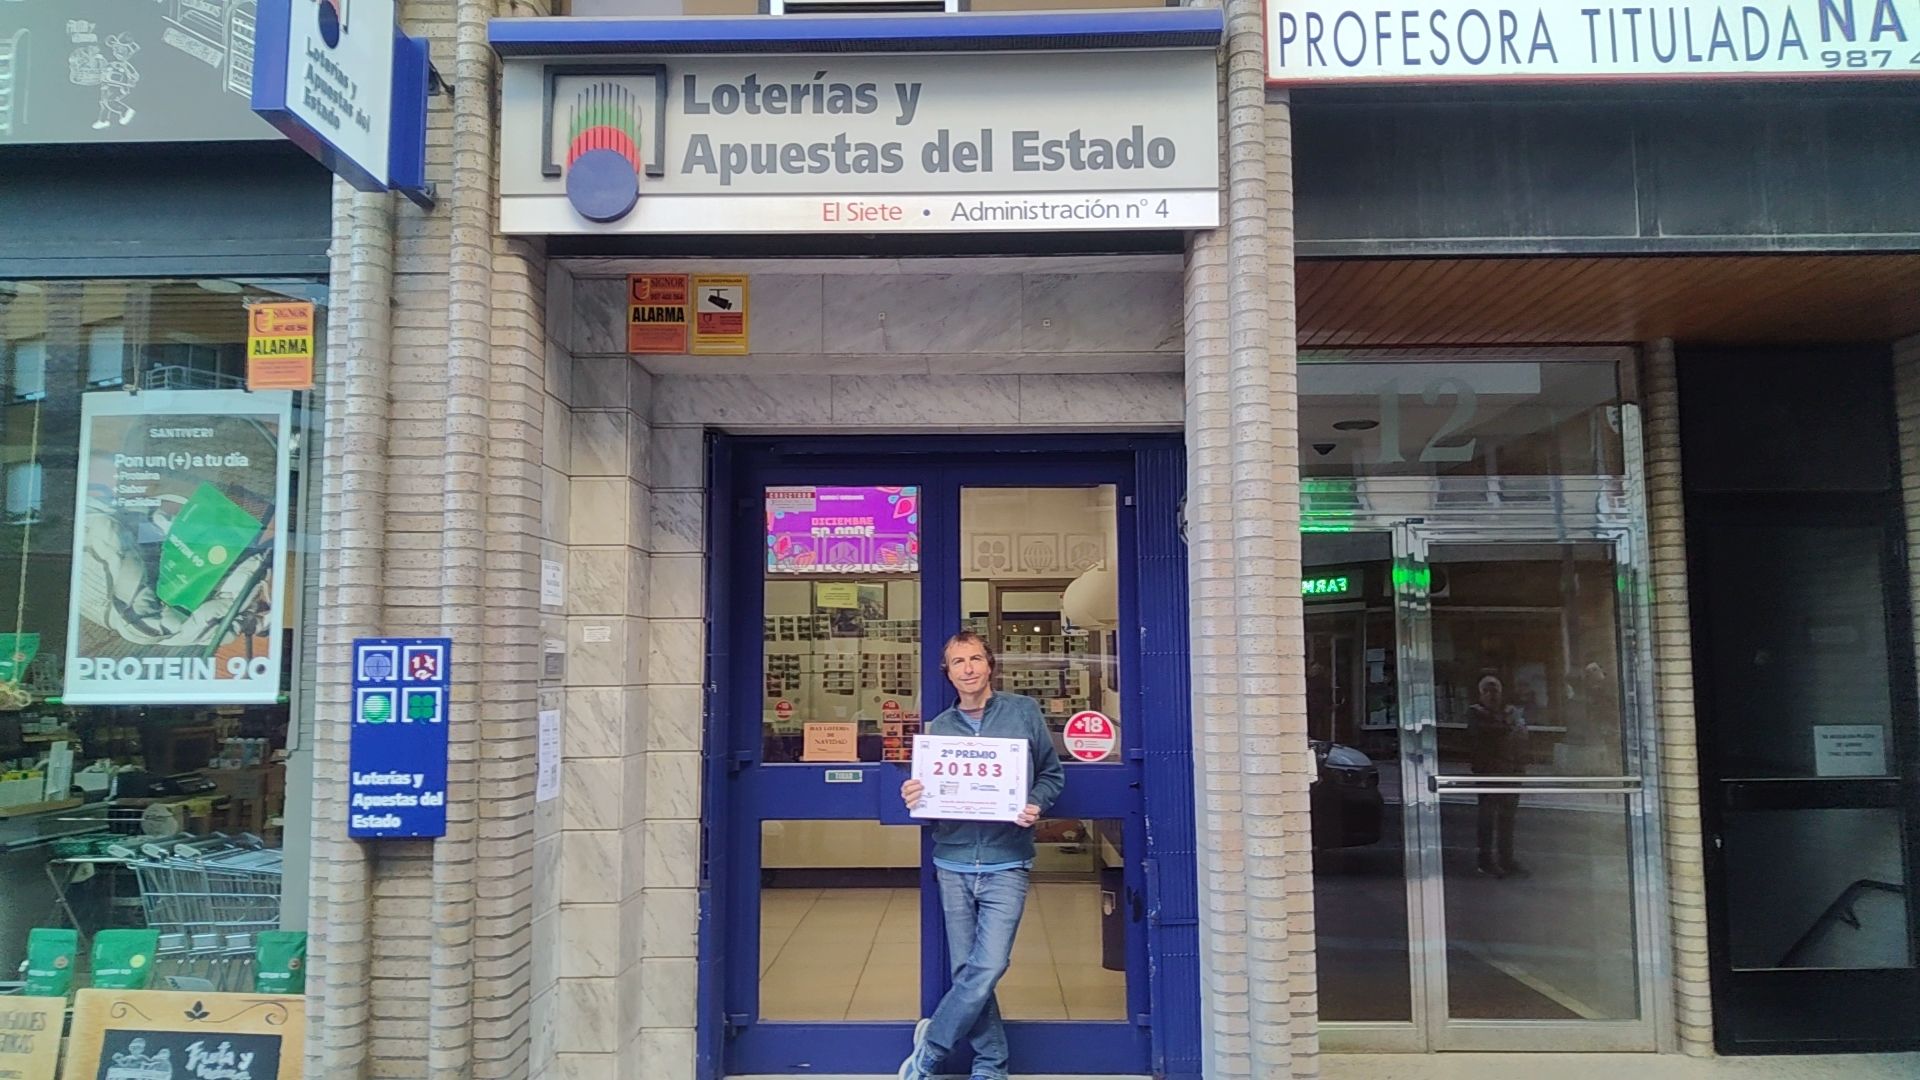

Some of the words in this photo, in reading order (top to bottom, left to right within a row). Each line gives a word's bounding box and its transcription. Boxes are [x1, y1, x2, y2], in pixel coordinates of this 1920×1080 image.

[1818, 0, 1920, 42] NA
[1279, 7, 1558, 67] PROFESORA
[1581, 5, 1808, 63] TITULADA
[305, 36, 350, 90] Loterías
[350, 81, 358, 101] y
[1821, 50, 1892, 68] 987
[304, 63, 354, 119] Apuestas
[355, 107, 371, 134] del
[682, 70, 878, 115] Loterías
[895, 82, 922, 125] y
[303, 86, 340, 130] Estado
[681, 132, 903, 186] Apuestas
[921, 128, 994, 173] del
[1011, 125, 1177, 172] Estado
[822, 202, 841, 222] El
[847, 200, 903, 222] Siete
[951, 198, 1119, 222] Administración
[1154, 200, 1170, 219] 4
[632, 307, 685, 323] ALARMA
[254, 339, 308, 355] ALARMA
[1376, 377, 1479, 463] 12
[149, 428, 214, 438] SANTIVERI
[114, 453, 144, 468] Pon
[145, 456, 166, 467] un
[168, 452, 192, 470] (+)
[192, 455, 204, 467] a
[204, 454, 223, 467] tu
[811, 517, 874, 526] DICIEMBRE
[75, 657, 217, 680] PROTEIN
[1074, 716, 1104, 733] +18
[955, 749, 997, 759] PREMIO
[352, 770, 411, 785] Loterías
[413, 773, 424, 788] y
[933, 762, 1003, 777] 20183
[352, 793, 418, 810] Apuestas
[420, 791, 444, 806] del
[352, 815, 401, 828] Estado
[237, 1052, 254, 1071] y
